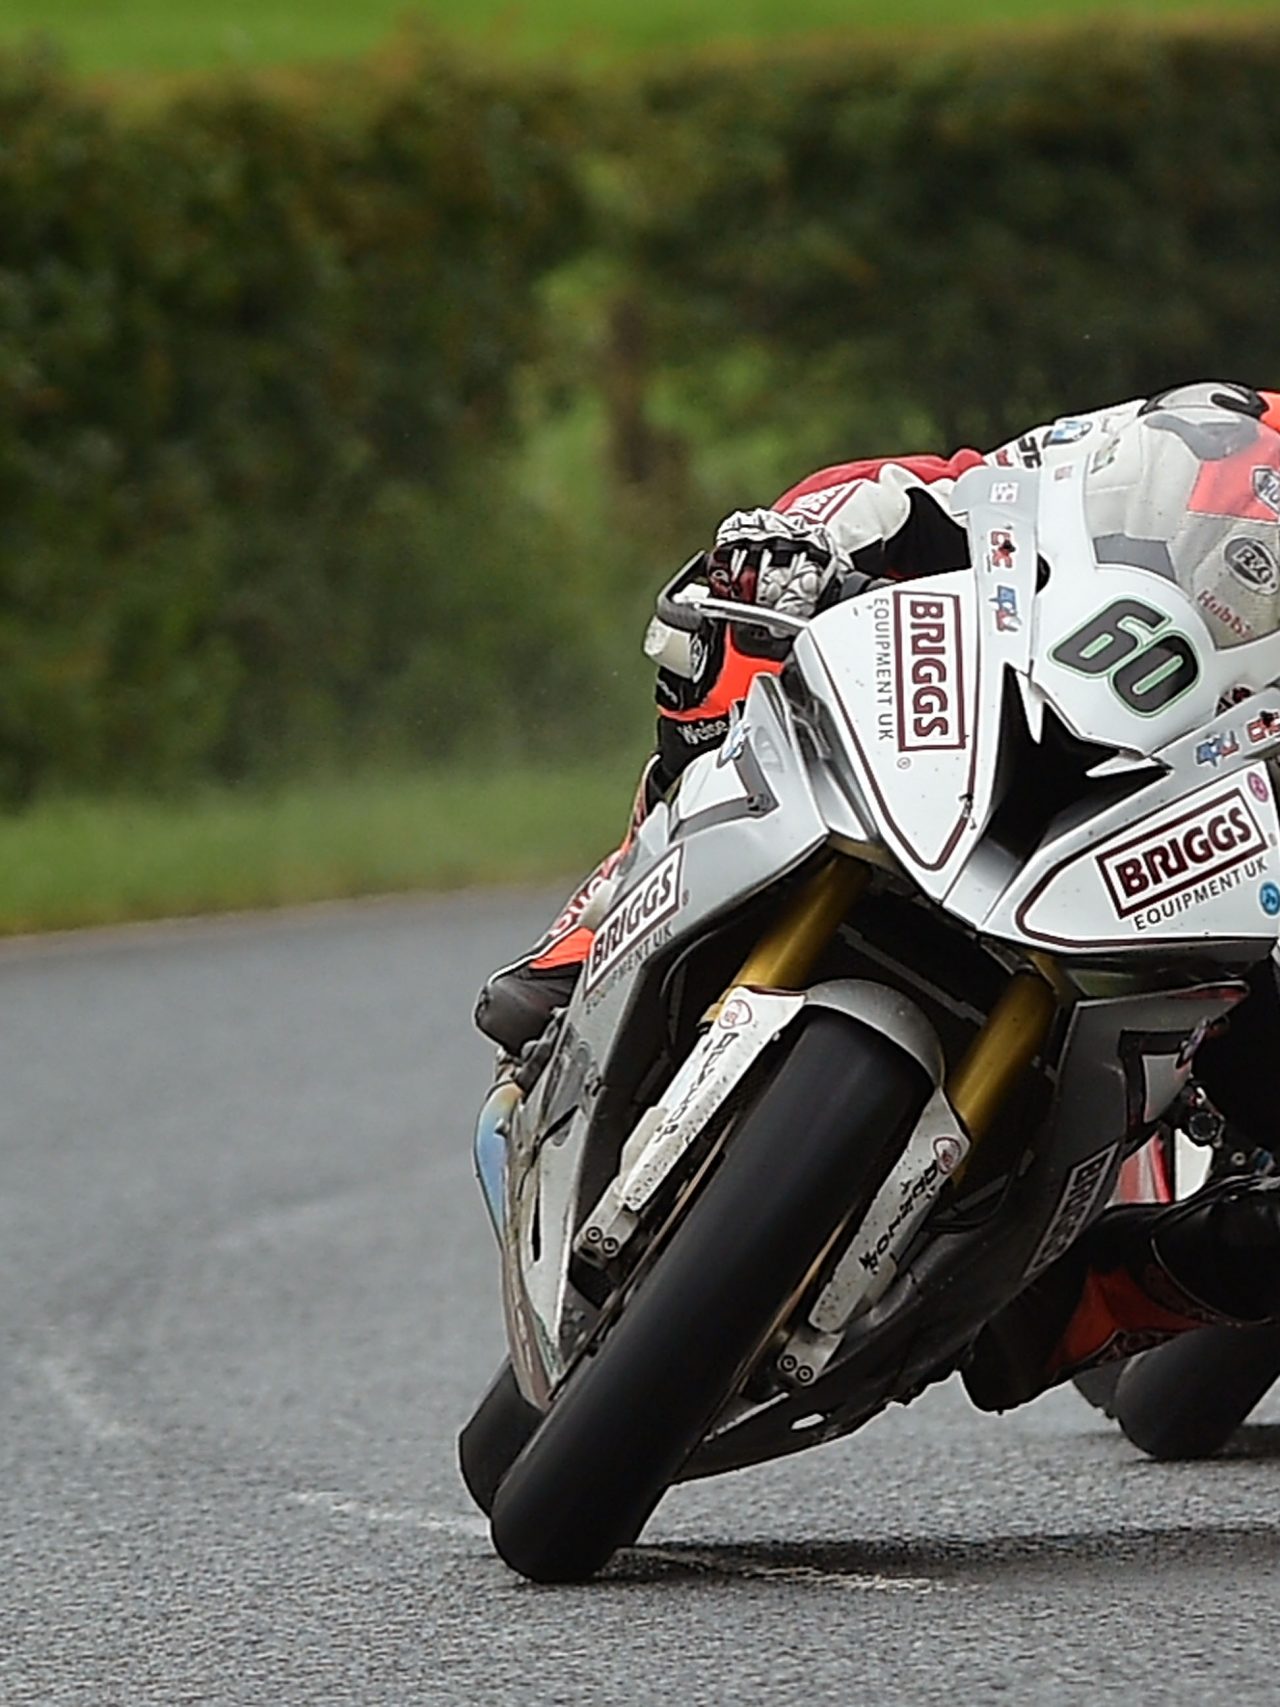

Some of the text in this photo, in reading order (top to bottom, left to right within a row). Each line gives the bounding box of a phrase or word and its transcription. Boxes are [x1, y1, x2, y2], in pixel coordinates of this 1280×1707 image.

[872, 597, 895, 742] EQUIPMENT UK
[909, 599, 948, 738] BRIGGS
[1048, 596, 1200, 718] 60
[1114, 806, 1253, 899] BRIGGS
[1133, 858, 1268, 932] EQUIPMENT UK
[591, 866, 674, 975] BRIGGS
[652, 924, 674, 946] UK
